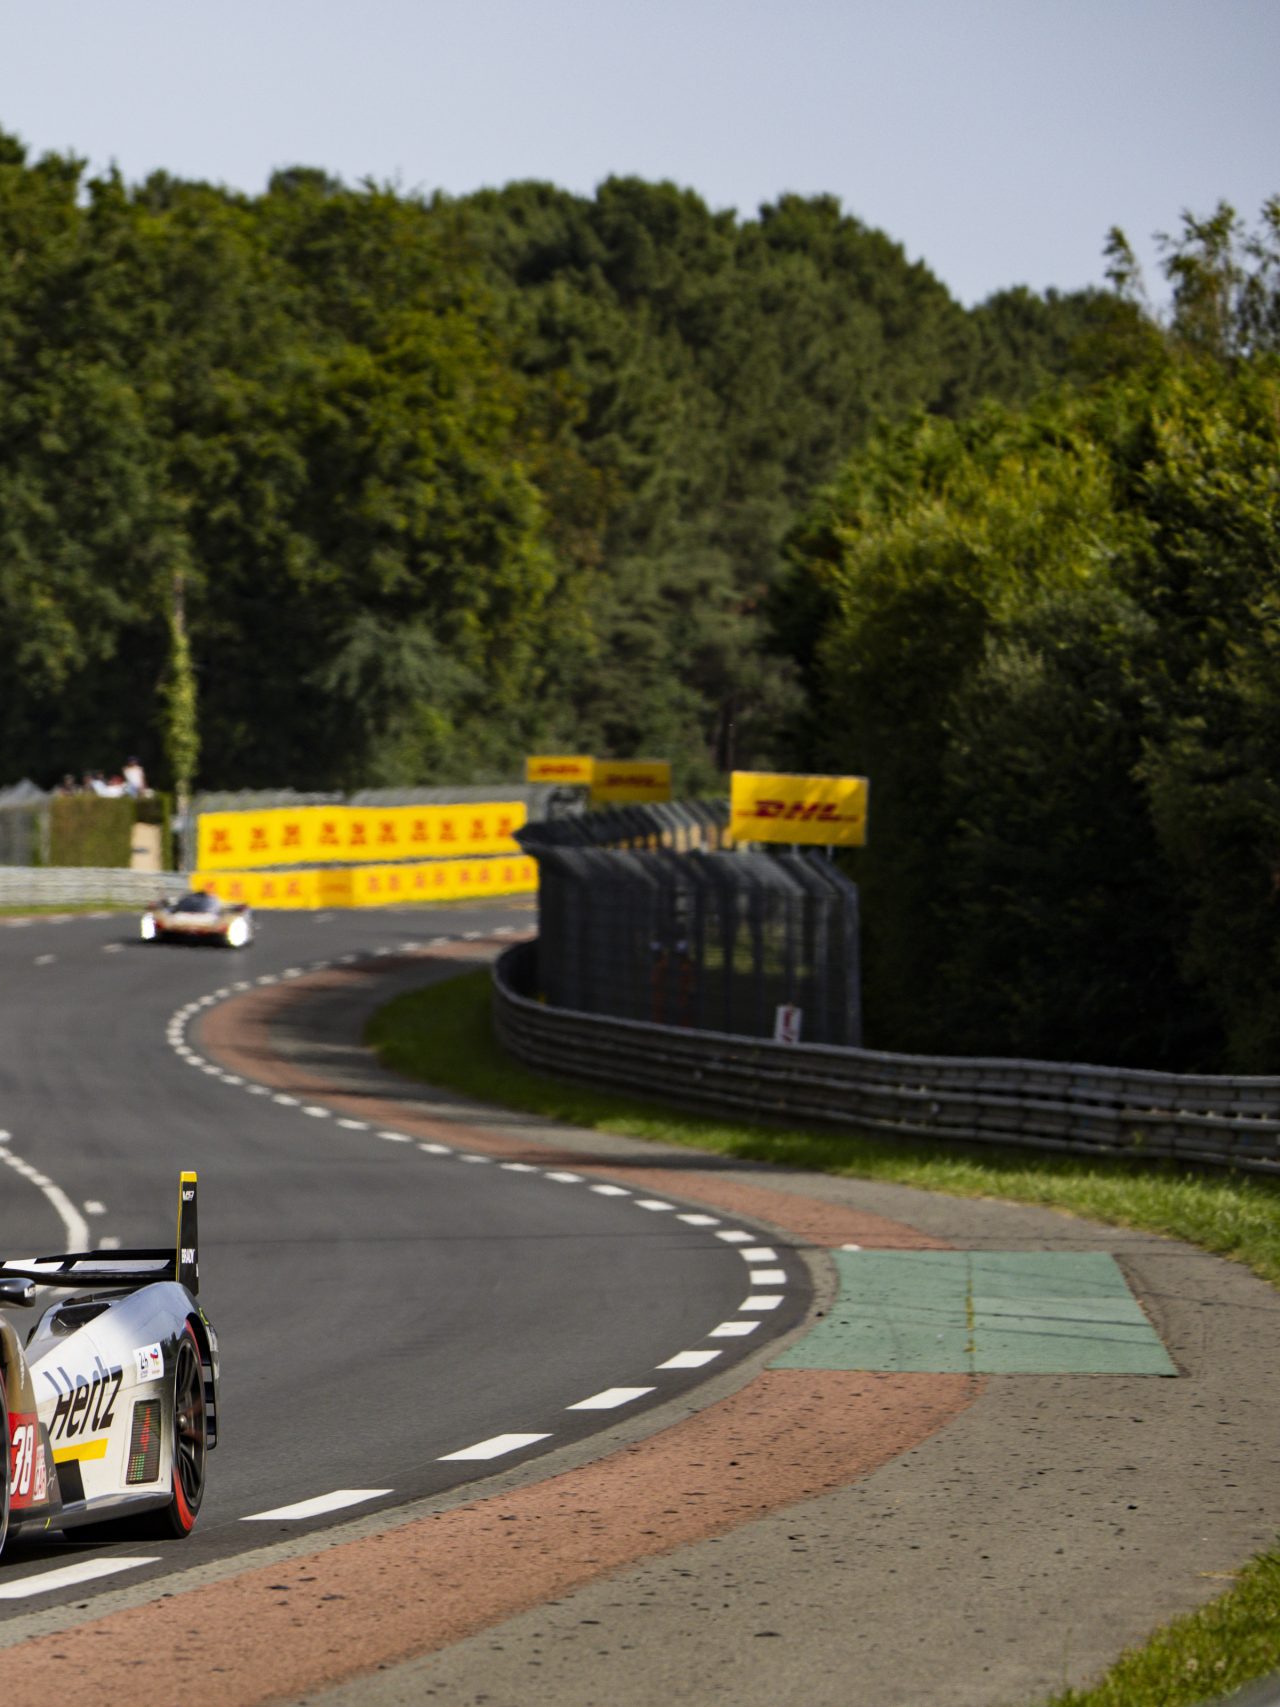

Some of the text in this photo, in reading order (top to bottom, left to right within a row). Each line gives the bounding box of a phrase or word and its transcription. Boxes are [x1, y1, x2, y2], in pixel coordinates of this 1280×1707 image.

[753, 799, 842, 822] DHL
[42, 1355, 123, 1440] Hertz
[10, 1424, 34, 1496] 38
